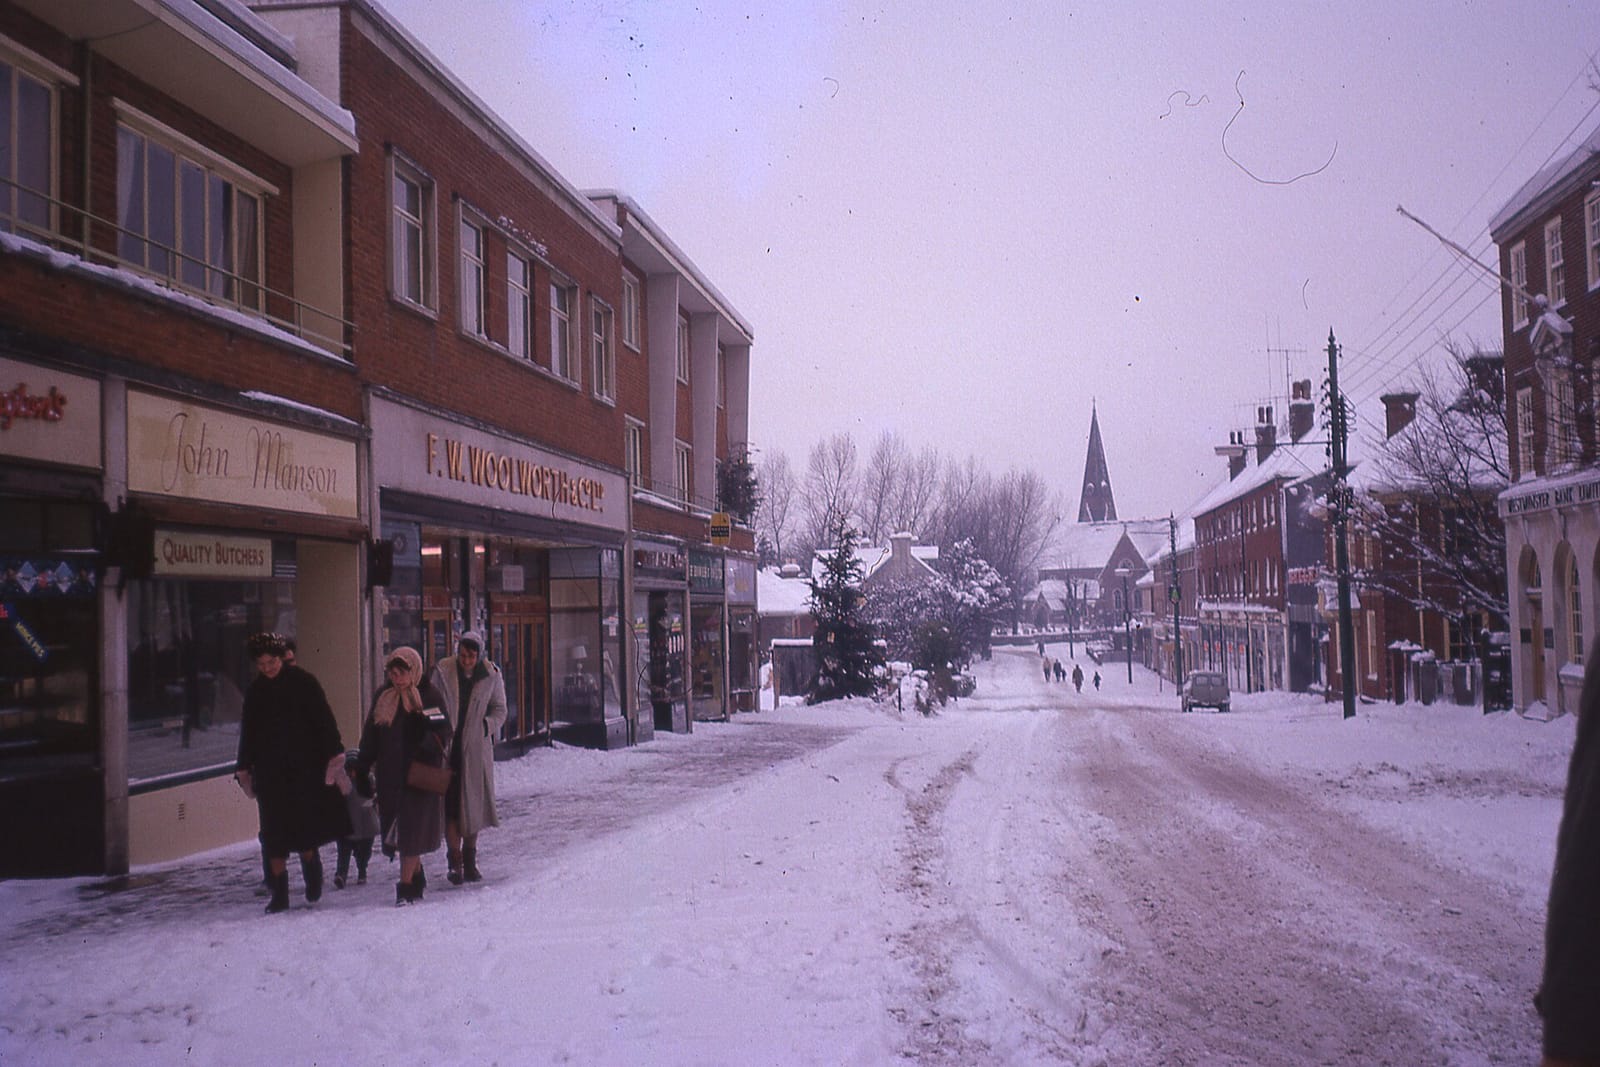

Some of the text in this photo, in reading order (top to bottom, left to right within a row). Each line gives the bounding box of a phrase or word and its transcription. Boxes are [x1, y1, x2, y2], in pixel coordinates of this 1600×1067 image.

[161, 412, 338, 494] John Manson
[468, 445, 568, 504] WOOLWORTH
[570, 479, 578, 507] &
[1554, 486, 1574, 505] BANK
[162, 538, 265, 567] QUALITY BUTCHERS
